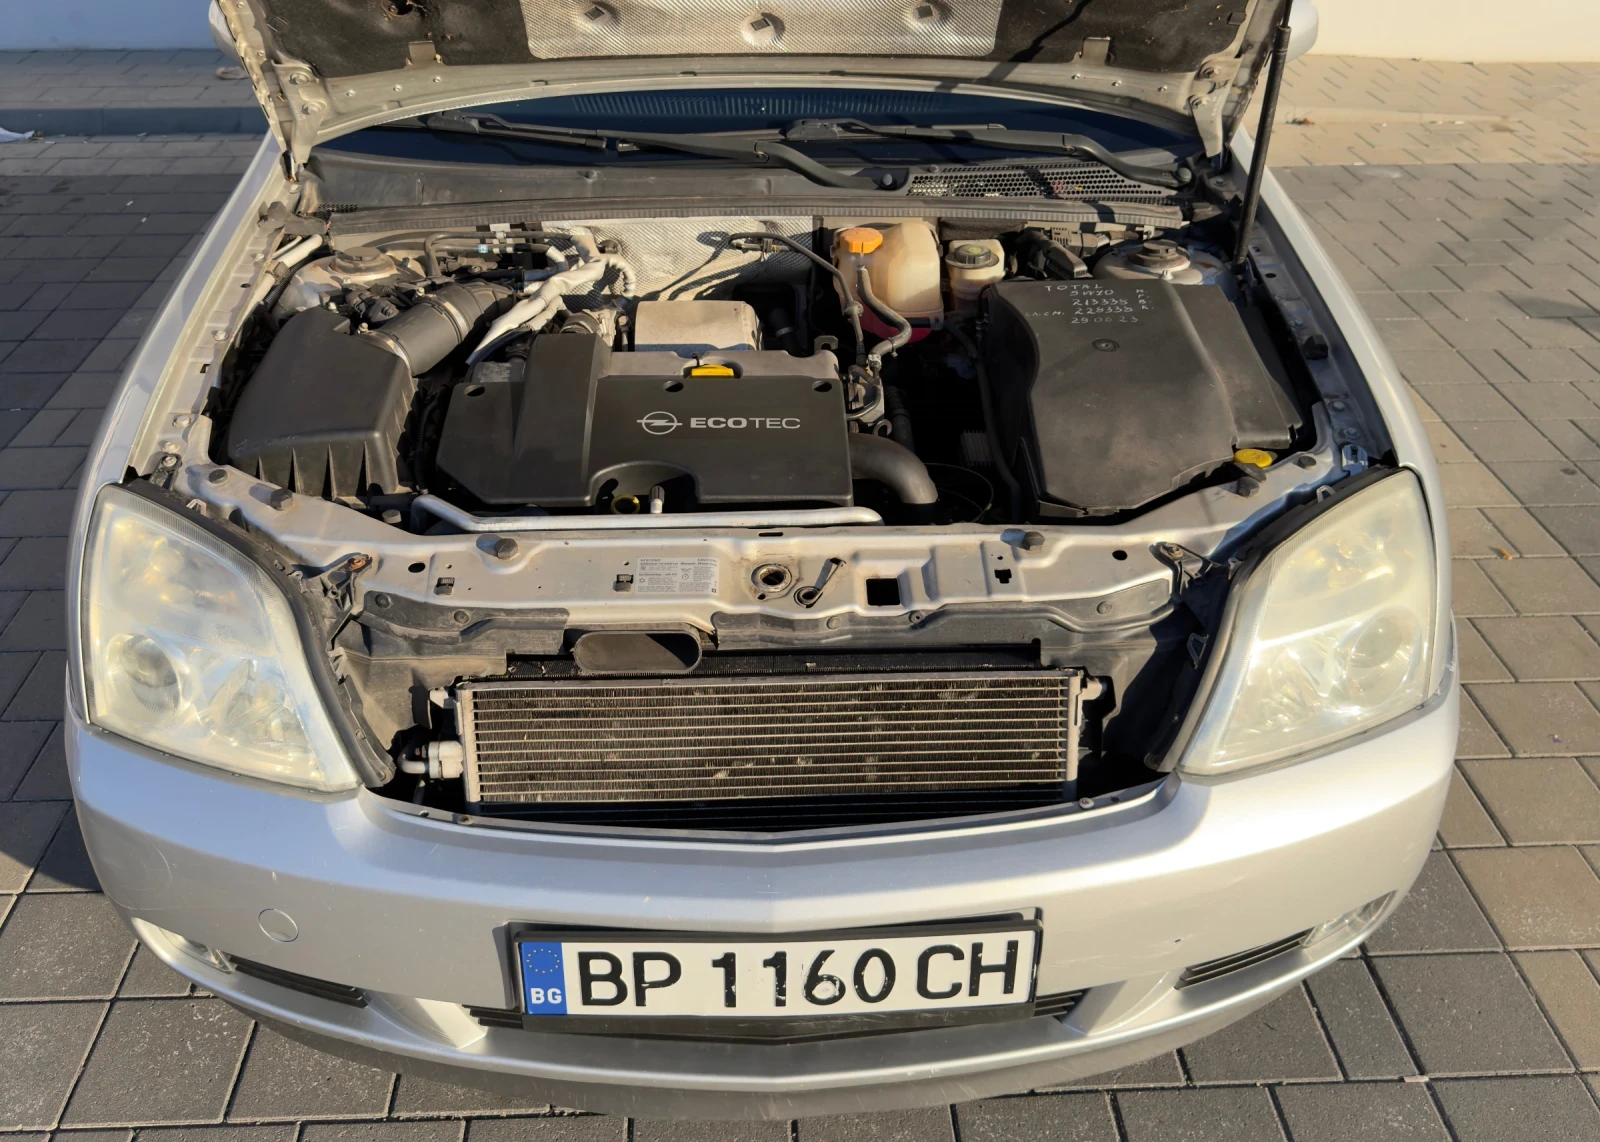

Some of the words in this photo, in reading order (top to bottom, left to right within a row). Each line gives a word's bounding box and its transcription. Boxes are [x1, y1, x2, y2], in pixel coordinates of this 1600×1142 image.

[1044, 284, 1103, 292] TOTAL
[690, 417, 801, 429] ECOTEC
[577, 950, 682, 1007] BP
[711, 947, 896, 1008] 1160
[916, 939, 1019, 1000] CH
[530, 987, 562, 1005] BG
